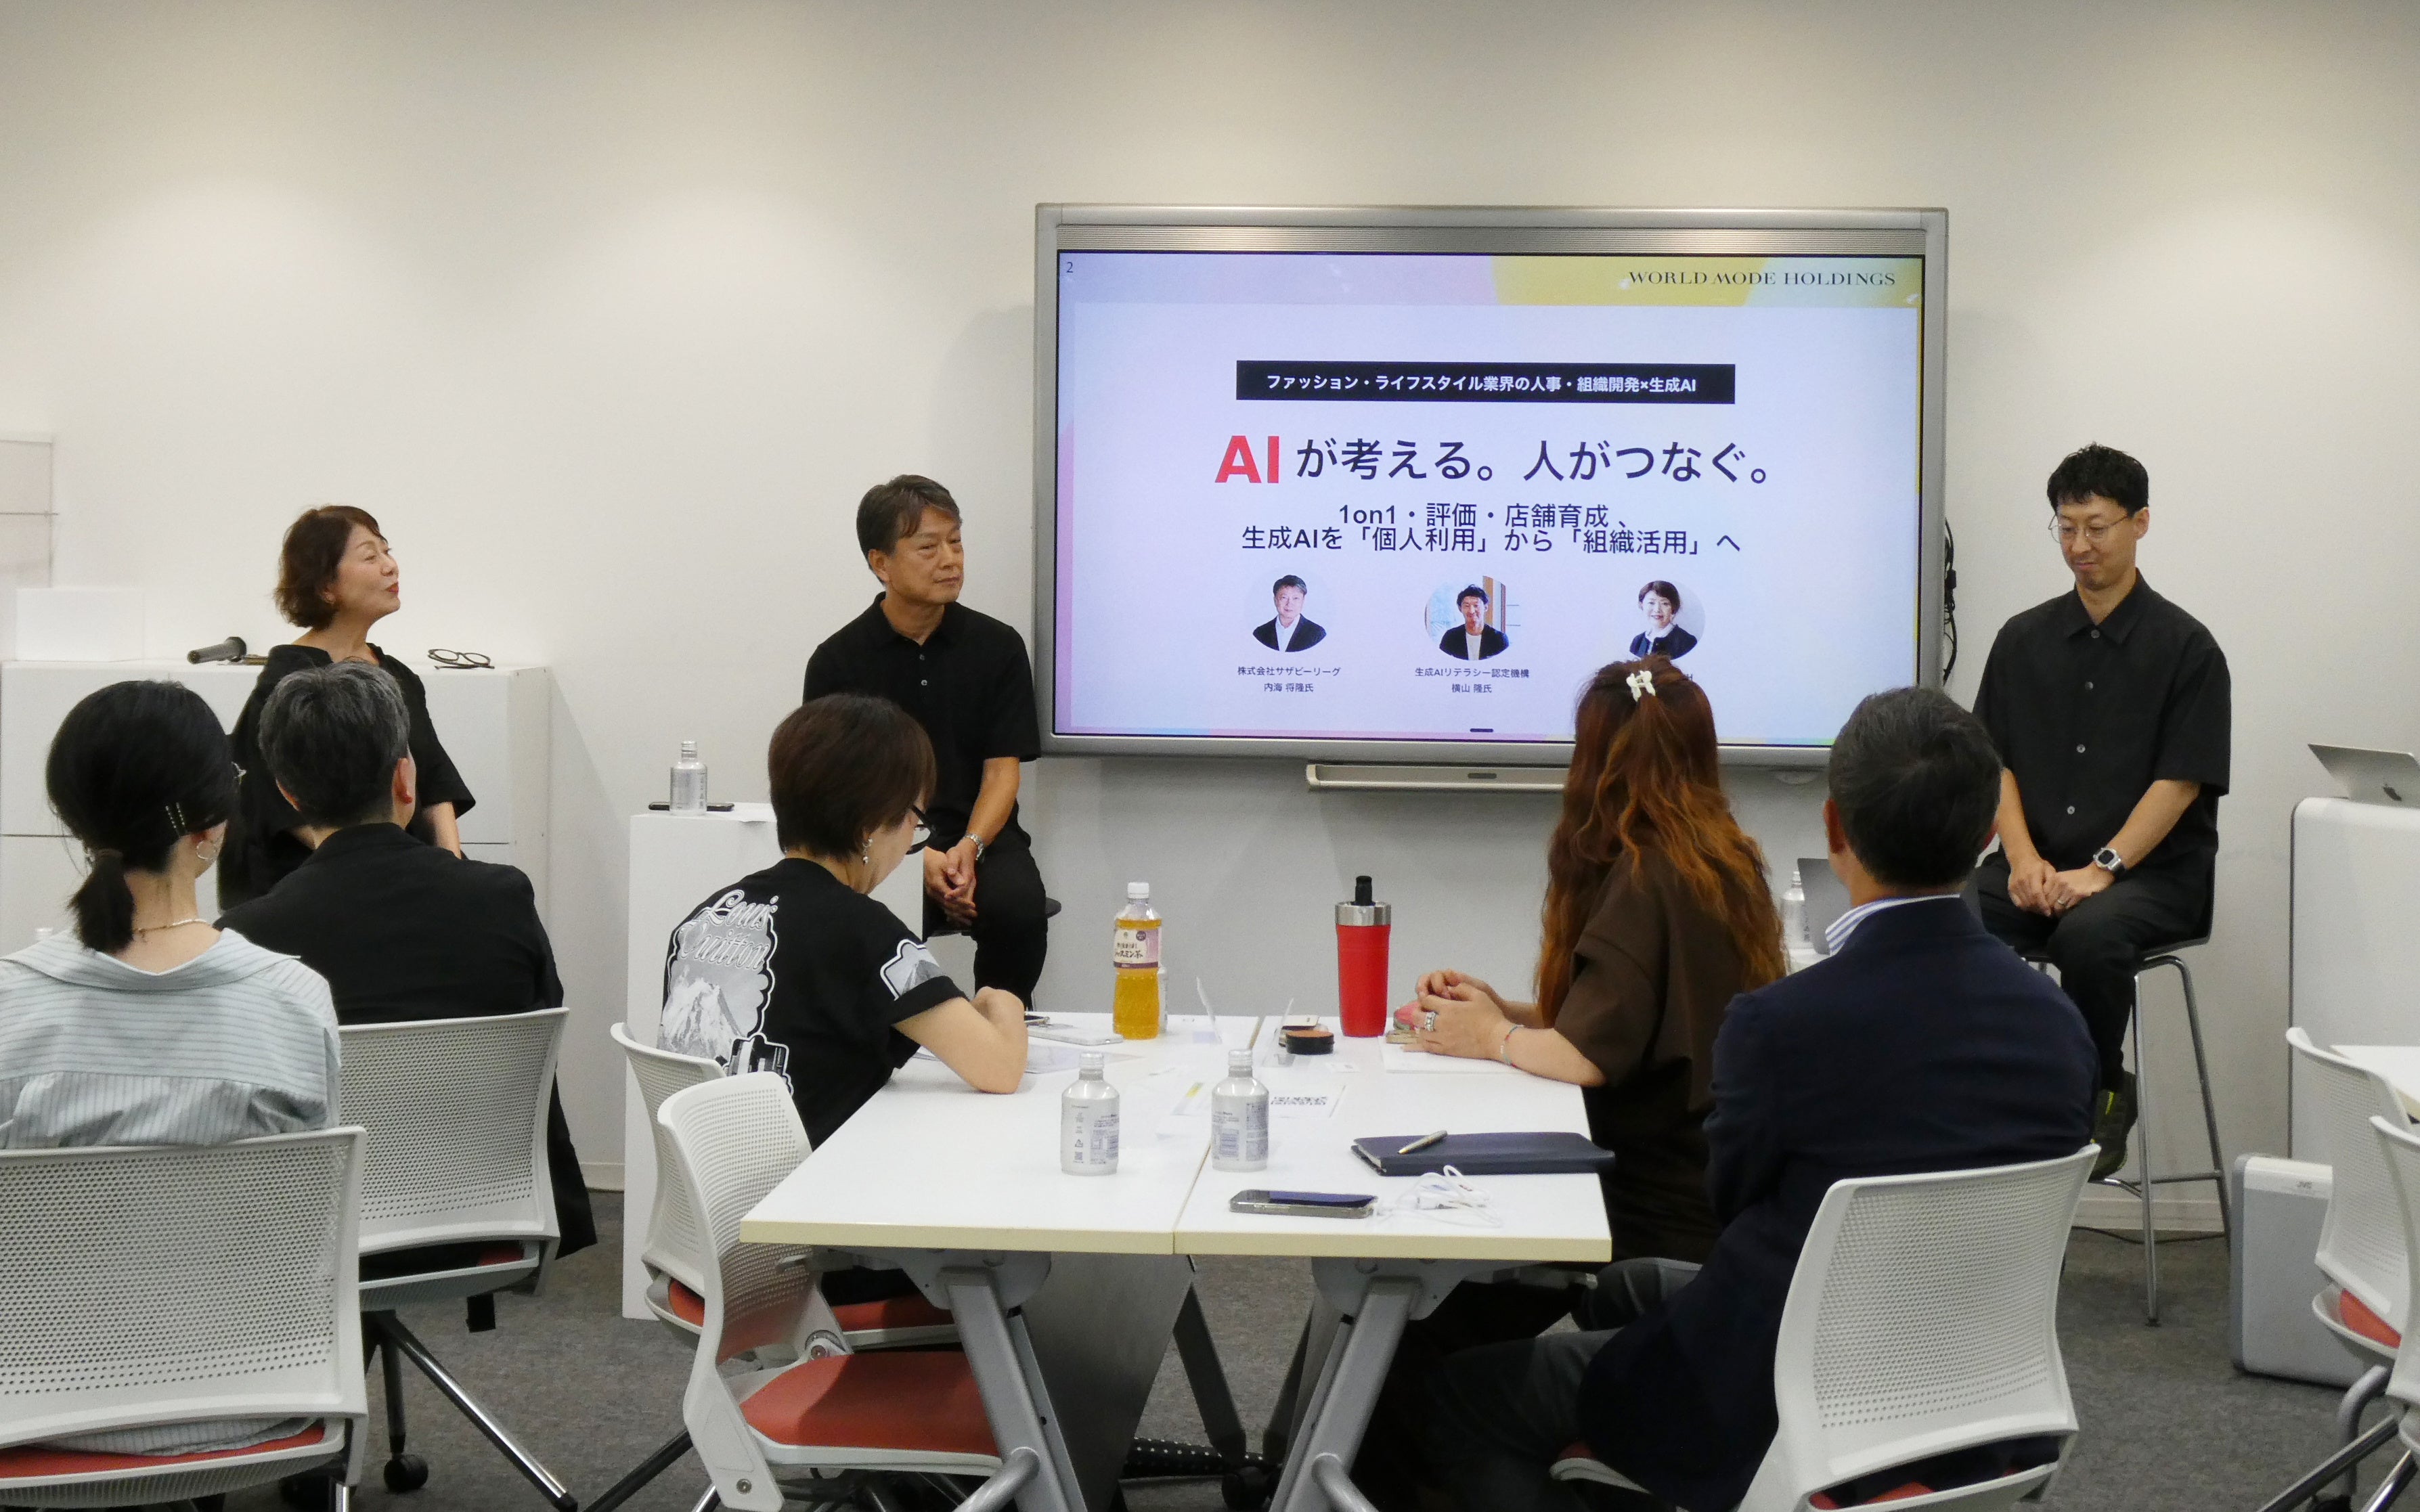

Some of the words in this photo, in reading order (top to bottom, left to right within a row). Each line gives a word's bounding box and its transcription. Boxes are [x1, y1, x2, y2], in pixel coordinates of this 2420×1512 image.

[1066, 261, 1074, 273] 2
[1629, 271, 1707, 285] WORLD
[1713, 271, 1776, 285] MODE
[1784, 271, 1896, 286] HOLDINGS
[1214, 435, 1279, 484] AI
[1237, 666, 1341, 676] 株式会社サザビーリーグ
[1415, 667, 1530, 678] 生成AIリテラシー認定機構
[1452, 683, 1470, 693] 横山
[700, 889, 778, 930] Louis
